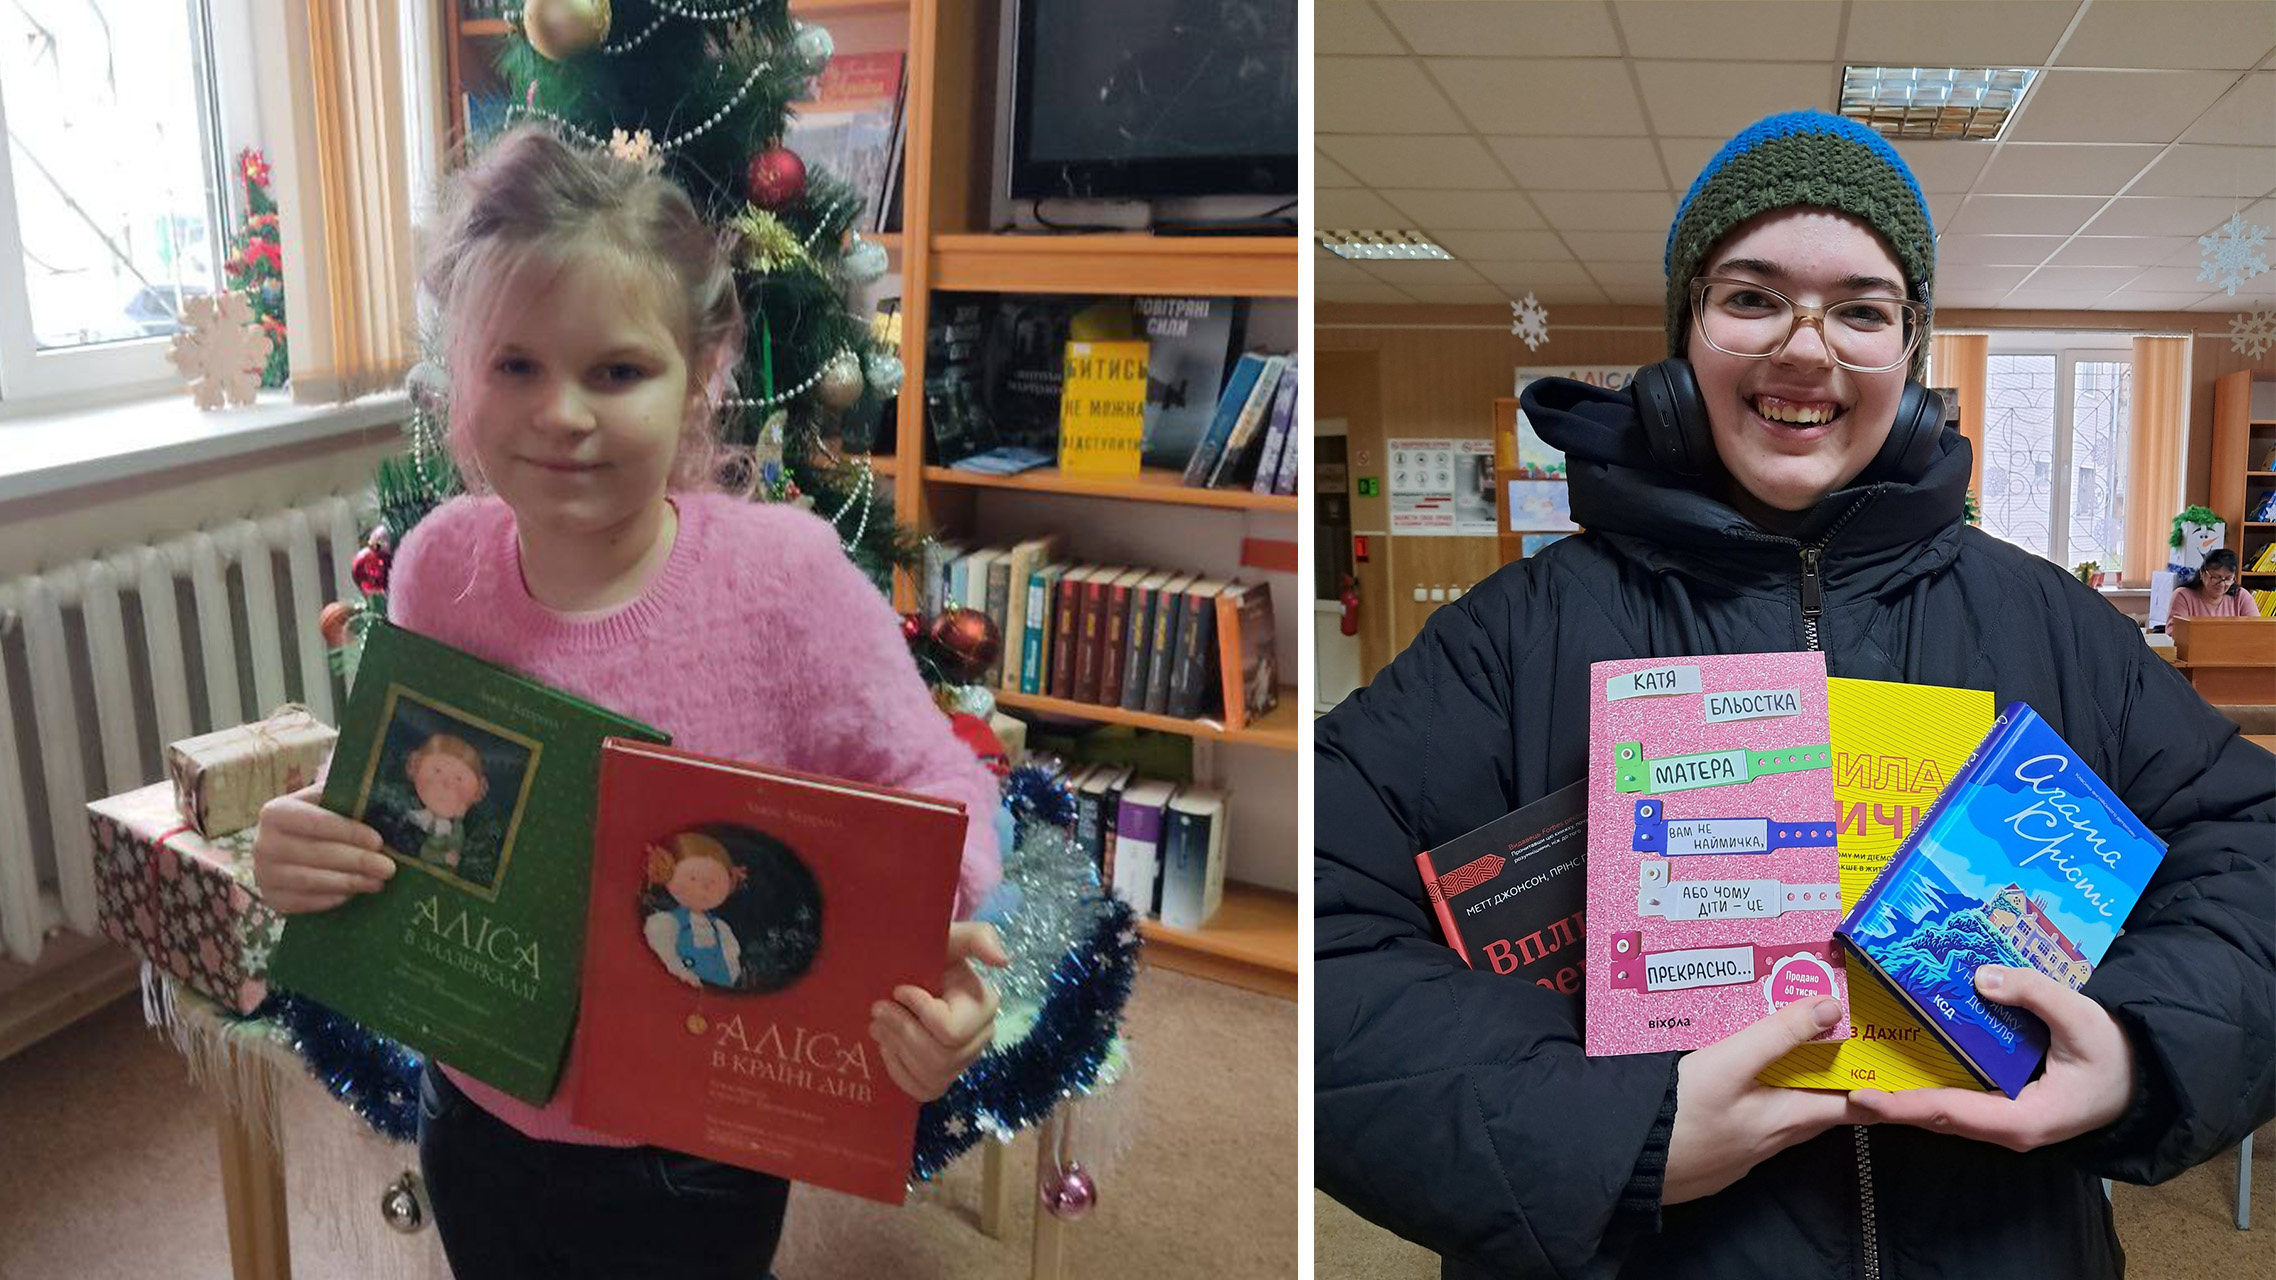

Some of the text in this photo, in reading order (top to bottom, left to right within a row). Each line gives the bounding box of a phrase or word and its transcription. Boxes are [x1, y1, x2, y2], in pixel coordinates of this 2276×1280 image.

[1146, 318, 1189, 338] СИЛИ
[1633, 670, 1677, 691] КАТЯ
[1710, 692, 1797, 716] БЛЬОСТКА
[1655, 757, 1735, 784] МАТЕРА
[2014, 754, 2122, 869] Агата
[1541, 822, 1564, 835] Forbes
[1561, 834, 1569, 842] до
[1569, 828, 1582, 837] того
[1669, 823, 1712, 839] ВАМ НЕ
[1694, 835, 1765, 850] НАЙМИЧКА,
[2003, 800, 2114, 917] Крісті
[1466, 897, 1493, 917] МЕТТ
[1494, 873, 1550, 906] ДЖОНСОН,
[1550, 858, 1581, 879] ПРІНС
[1683, 886, 1750, 900] АБО ЧОМУ
[1698, 901, 1728, 918] ДІТИ
[1747, 899, 1764, 913] ЦЕ
[412, 895, 541, 981] АЛІСА
[1648, 960, 1752, 984] ПРЕКРАСНО...
[1785, 970, 1820, 984] Продано
[1955, 961, 1967, 973] У
[1784, 985, 1818, 997] 60 тисяч
[1933, 993, 1956, 1020] КСД
[1965, 994, 2015, 1045] ДО НУЛЯ
[716, 1013, 871, 1080] АЛІСА
[712, 1050, 726, 1067] В
[817, 1076, 873, 1102] ДИВ
[1850, 1068, 1876, 1081] КСД
